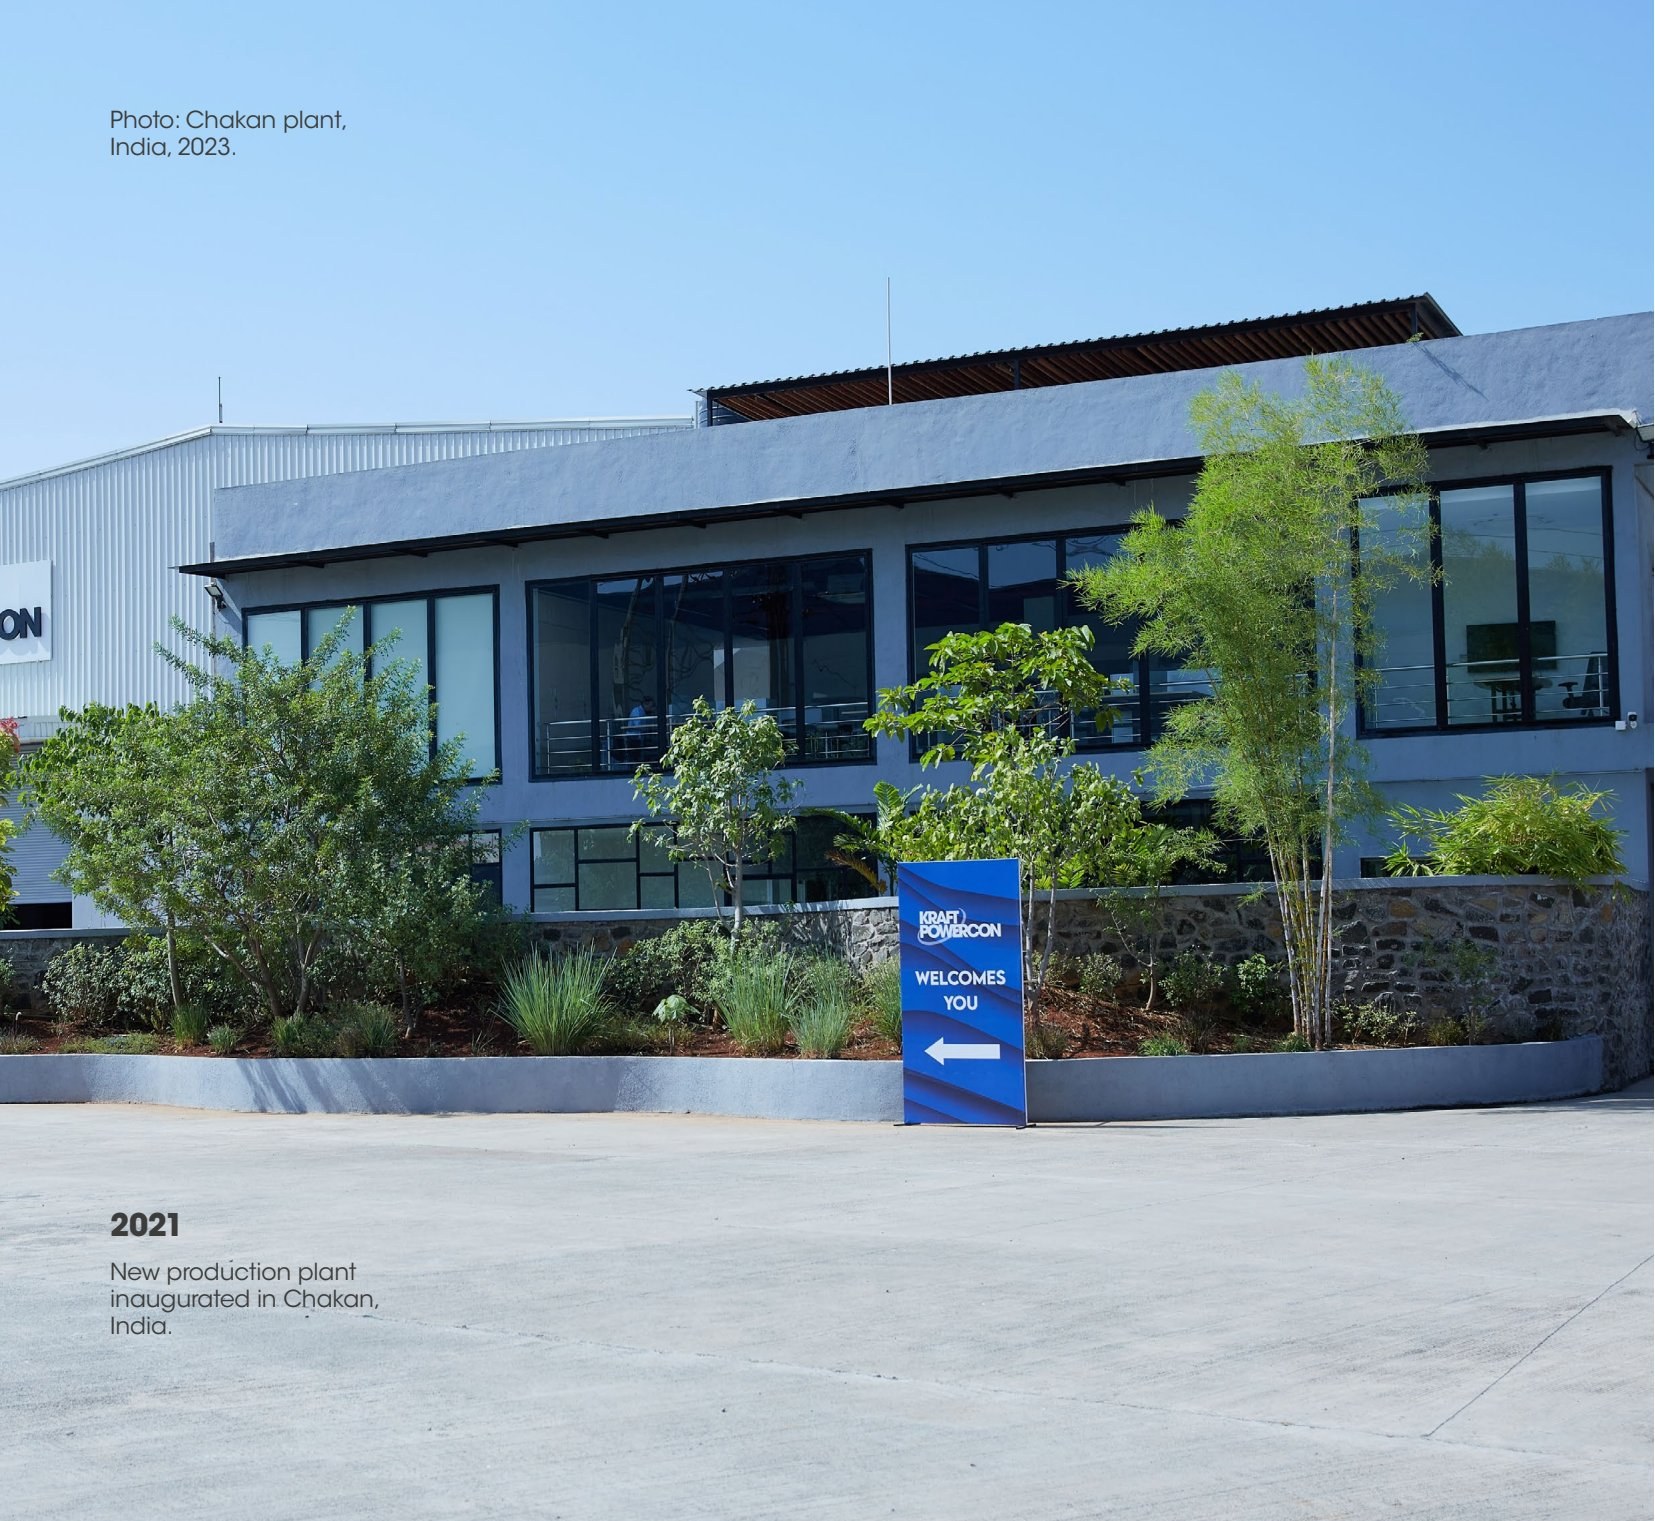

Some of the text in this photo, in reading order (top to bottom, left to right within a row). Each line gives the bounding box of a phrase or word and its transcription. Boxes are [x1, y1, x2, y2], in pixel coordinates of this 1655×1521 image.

[919, 910, 960, 925] KRAFT
[919, 923, 1002, 938] POWERCON
[915, 970, 1006, 986] WELCOMES
[944, 995, 978, 1011] YOU
